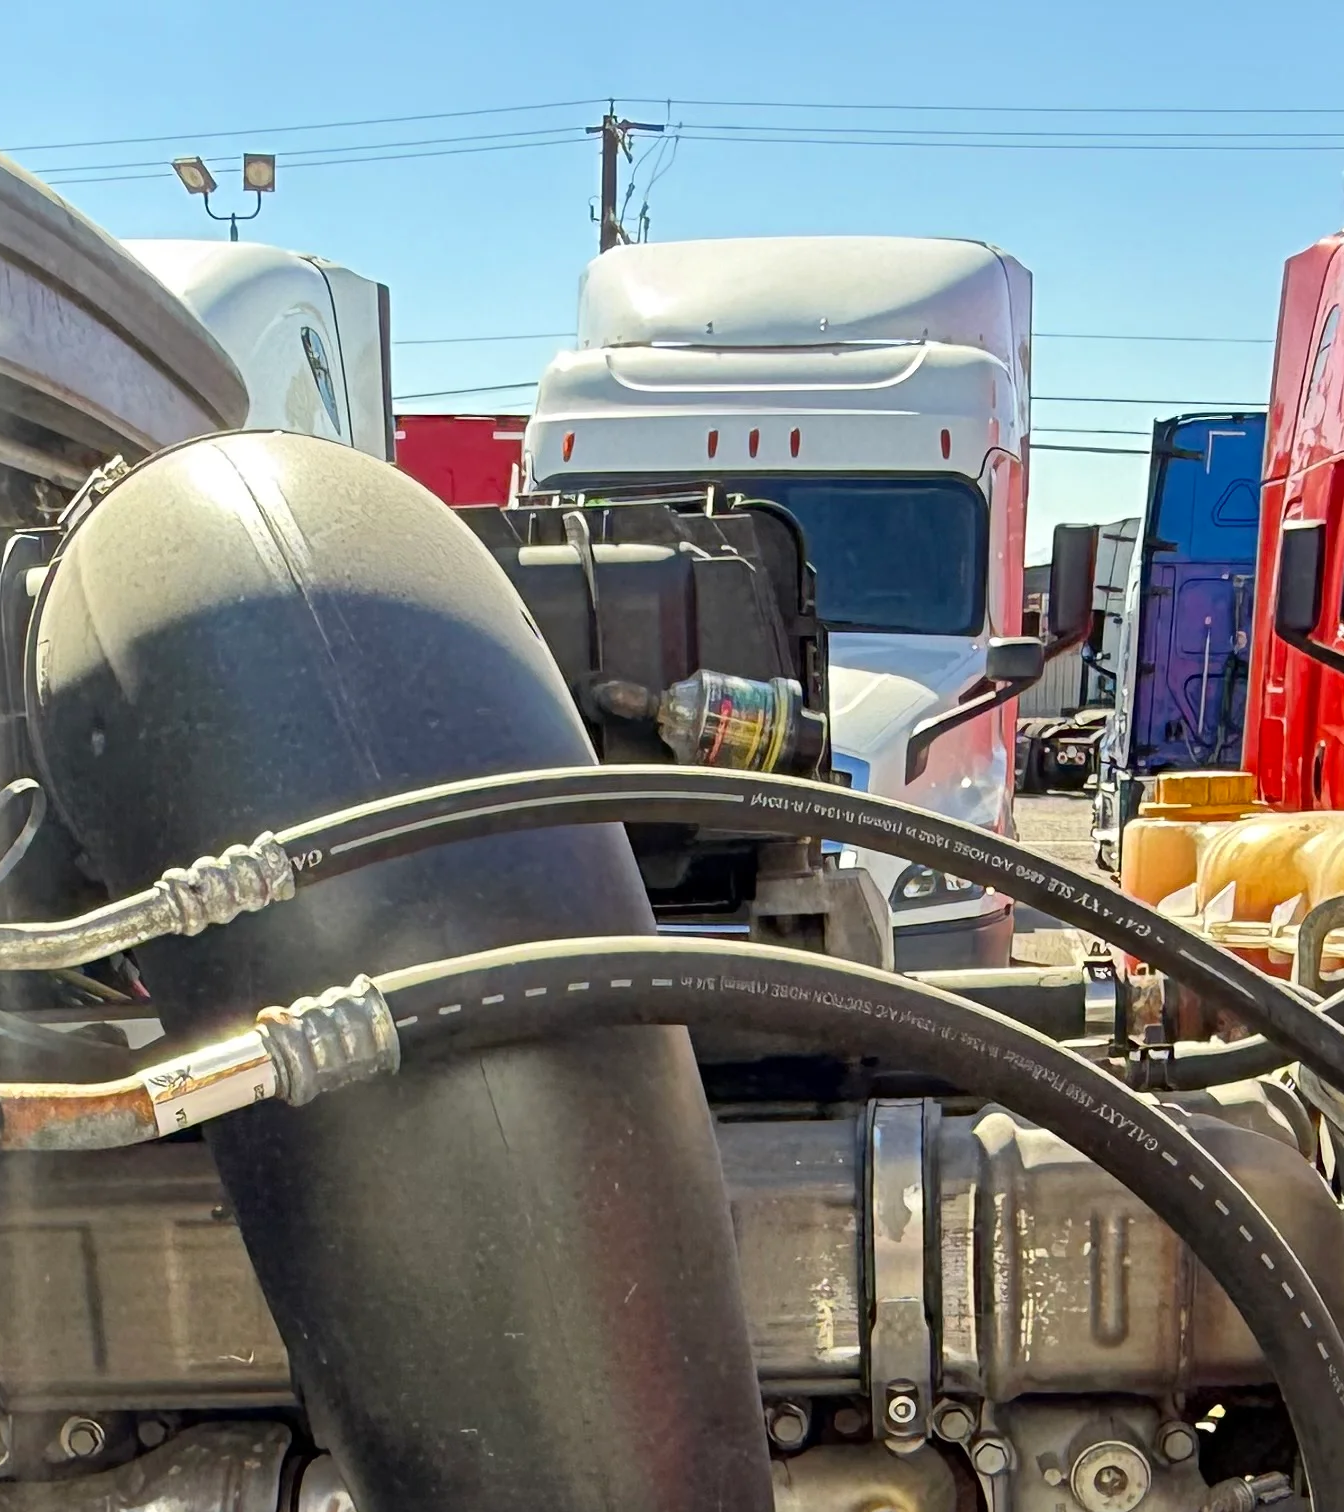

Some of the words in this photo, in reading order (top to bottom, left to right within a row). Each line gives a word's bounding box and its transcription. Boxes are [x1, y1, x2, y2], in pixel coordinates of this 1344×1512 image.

[813, 804, 855, 823] R-134a
[953, 841, 991, 864] HOSE
[815, 991, 873, 1015] SUCTION
[1093, 1102, 1158, 1151] GALAXY
